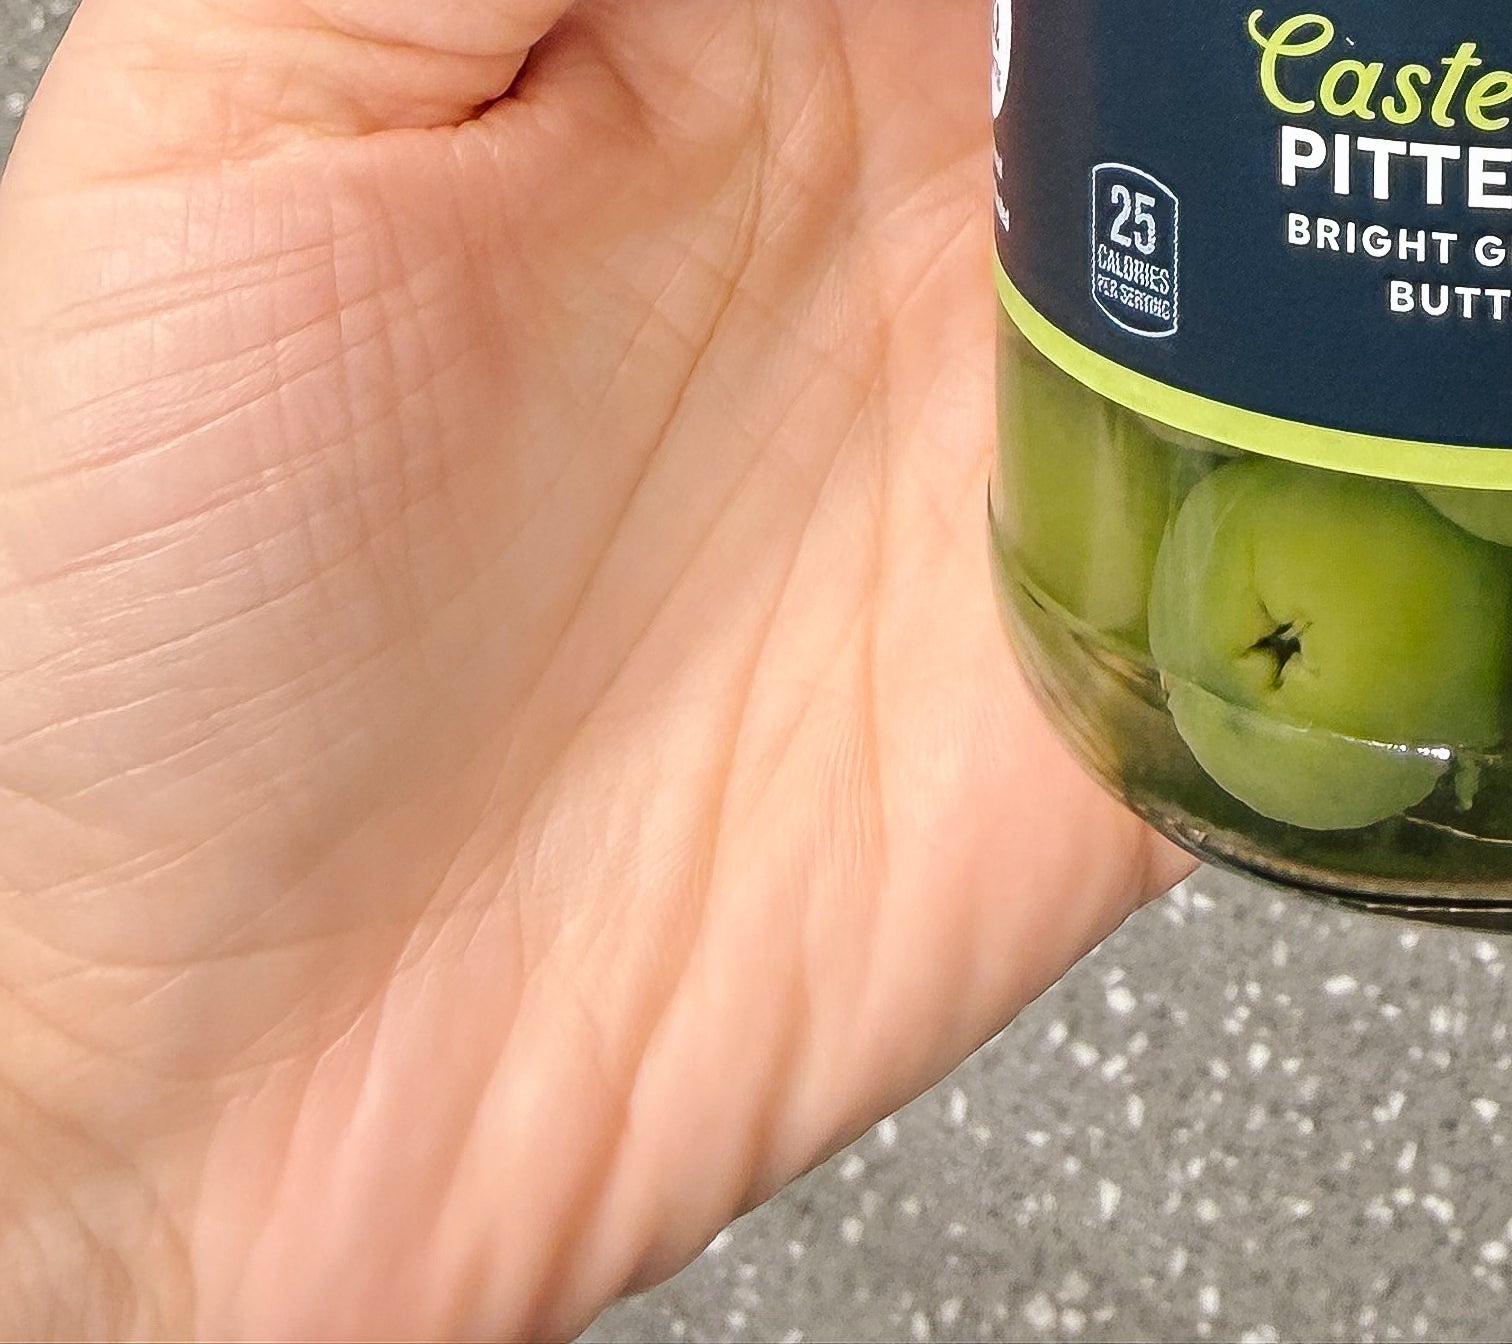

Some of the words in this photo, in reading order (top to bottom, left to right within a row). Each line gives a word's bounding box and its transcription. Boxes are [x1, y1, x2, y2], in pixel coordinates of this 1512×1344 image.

[1109, 183, 1157, 255] 25
[1286, 212, 1459, 265] BRIGHT
[1097, 243, 1171, 295] CALORIES
